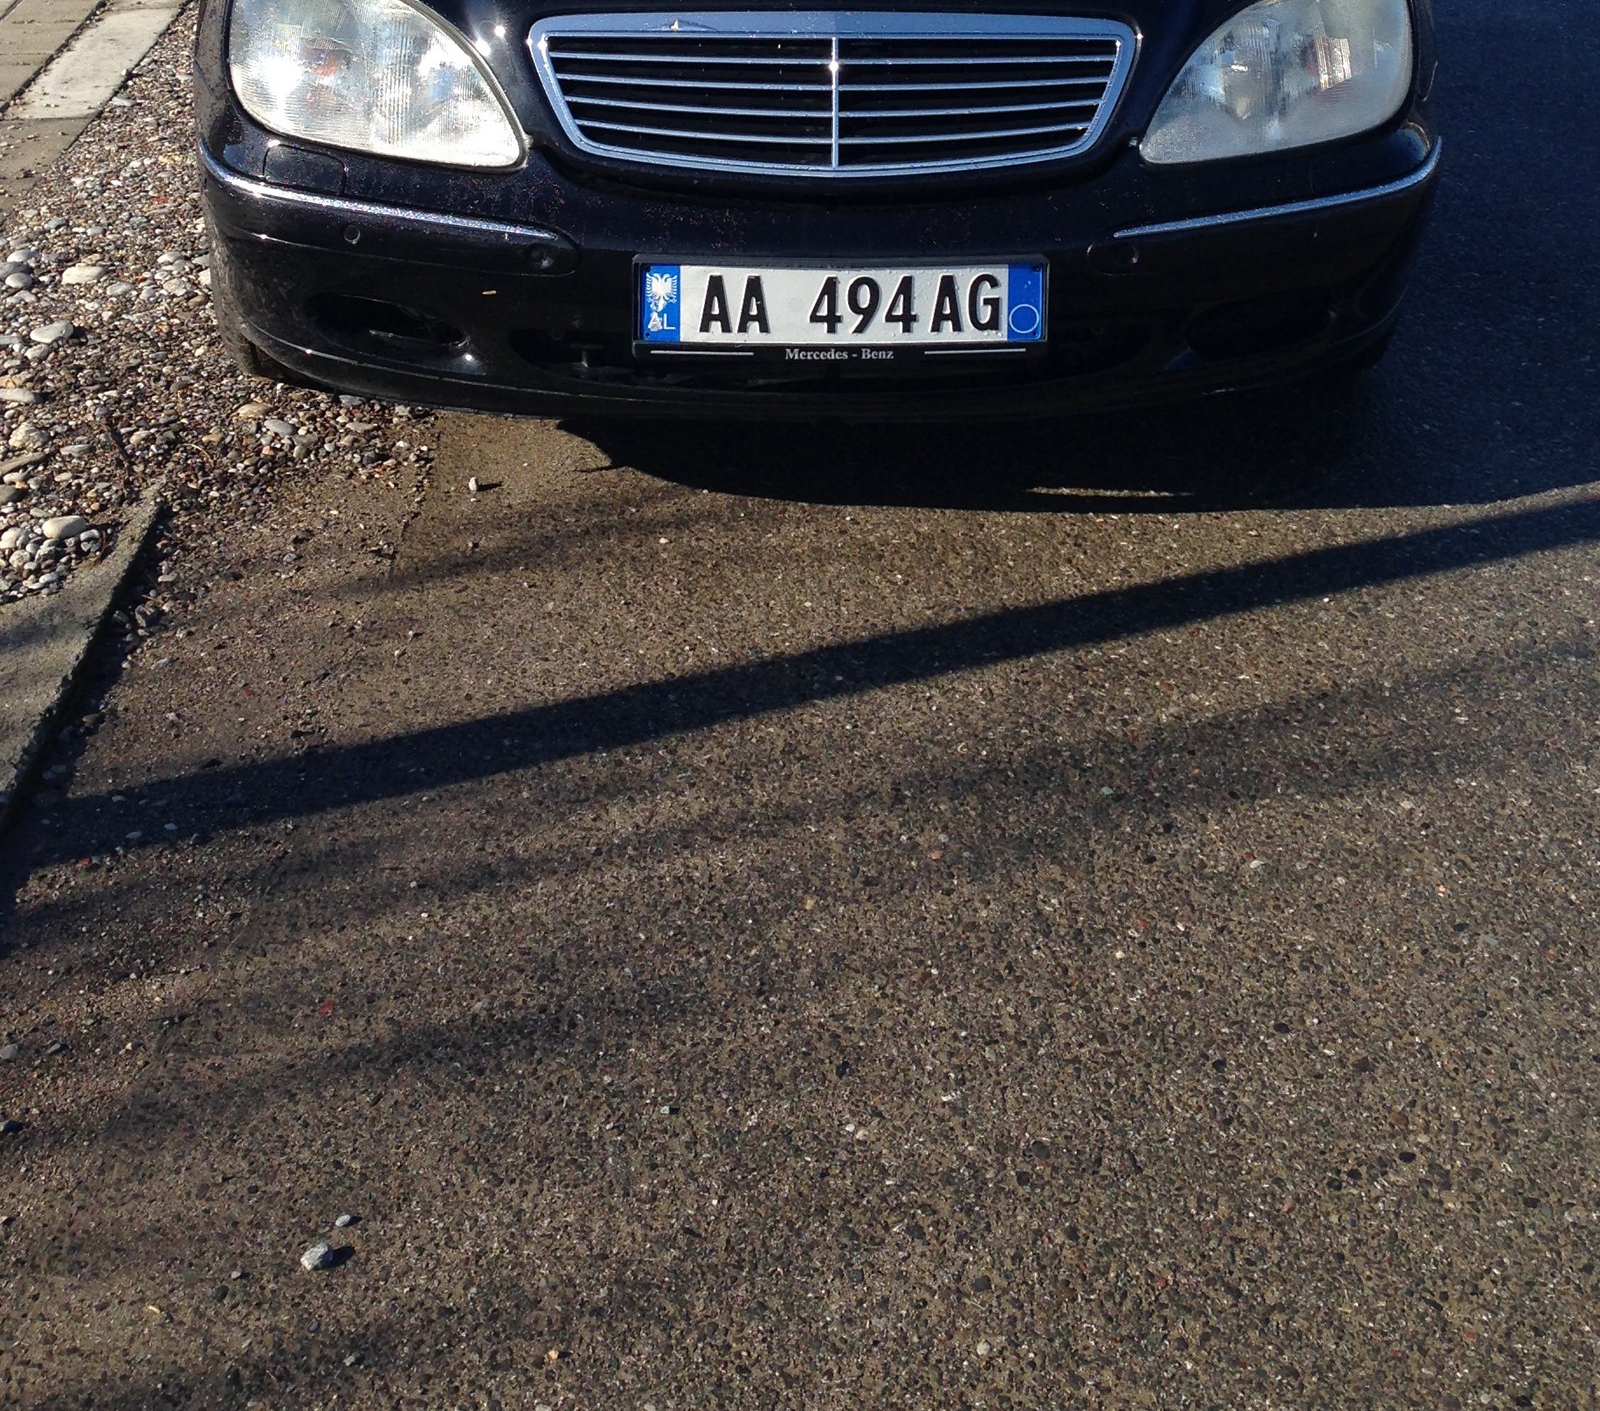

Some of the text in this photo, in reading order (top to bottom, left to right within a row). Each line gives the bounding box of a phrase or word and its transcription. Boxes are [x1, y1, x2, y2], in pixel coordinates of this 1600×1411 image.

[700, 273, 1000, 334] AA 494 AG
[648, 311, 676, 331] AL
[785, 348, 848, 360] Mercedes
[861, 348, 894, 360] Benz
